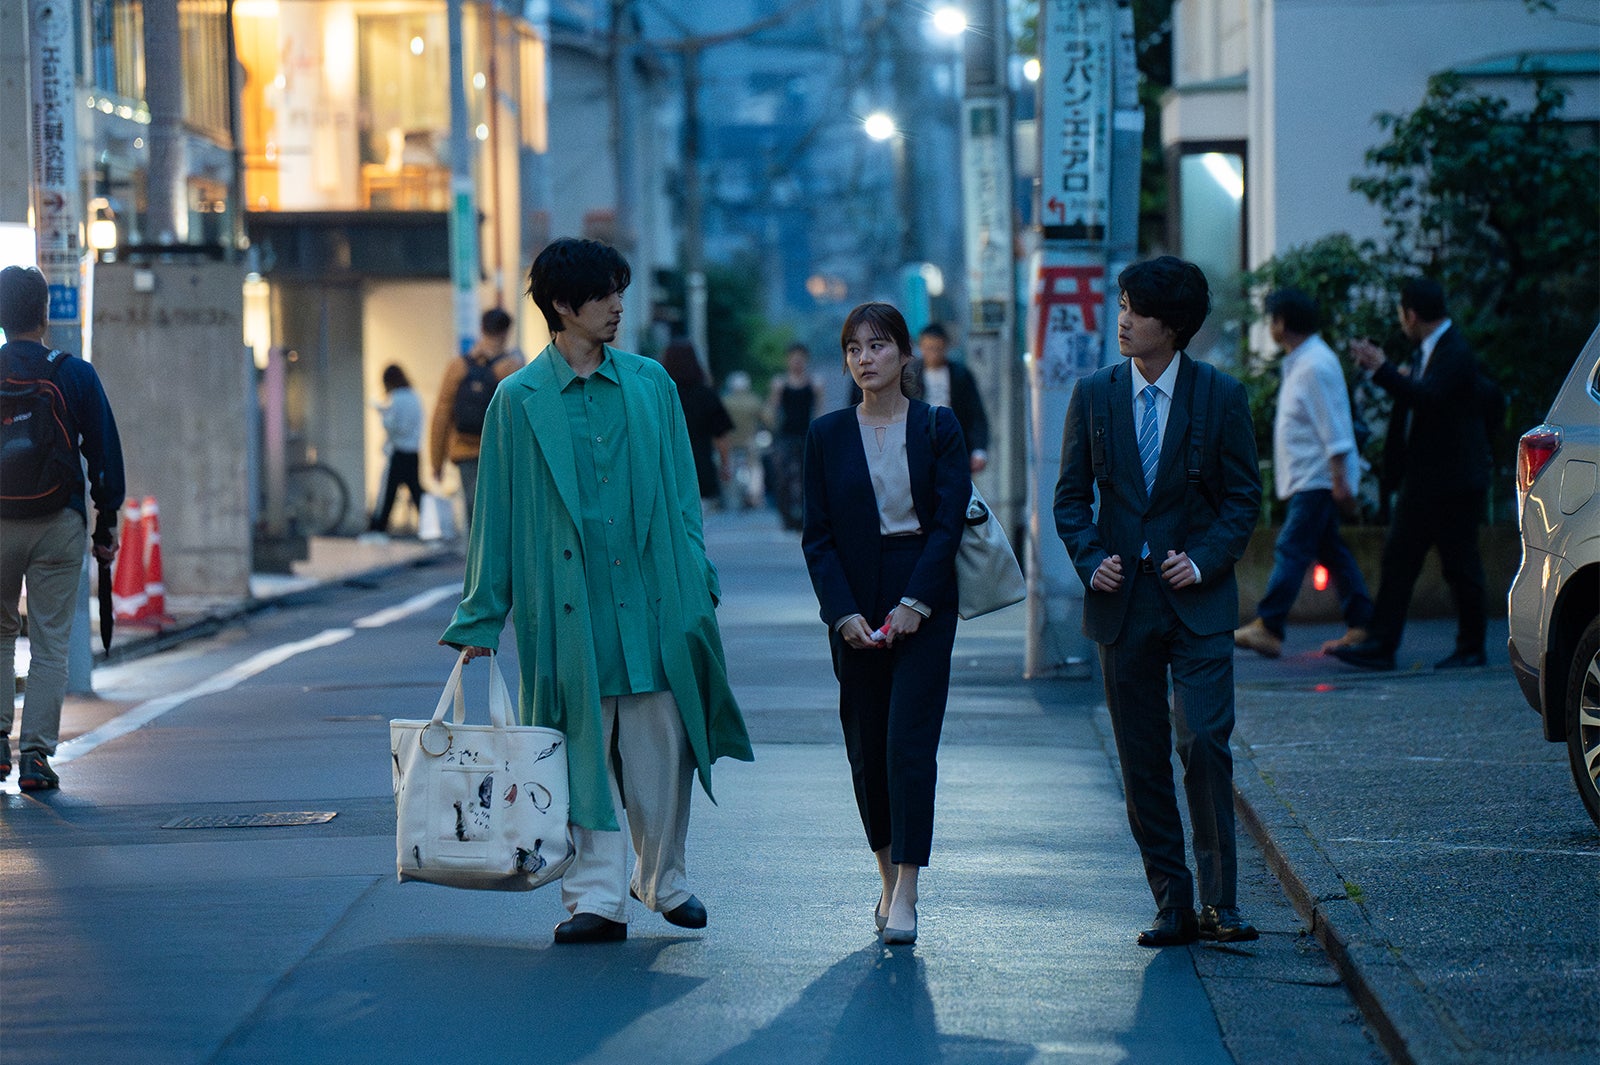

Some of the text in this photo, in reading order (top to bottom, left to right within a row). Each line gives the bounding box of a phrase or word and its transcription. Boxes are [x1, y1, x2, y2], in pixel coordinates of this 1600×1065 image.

[1062, 40, 1093, 192] ラパン・エ・アロ
